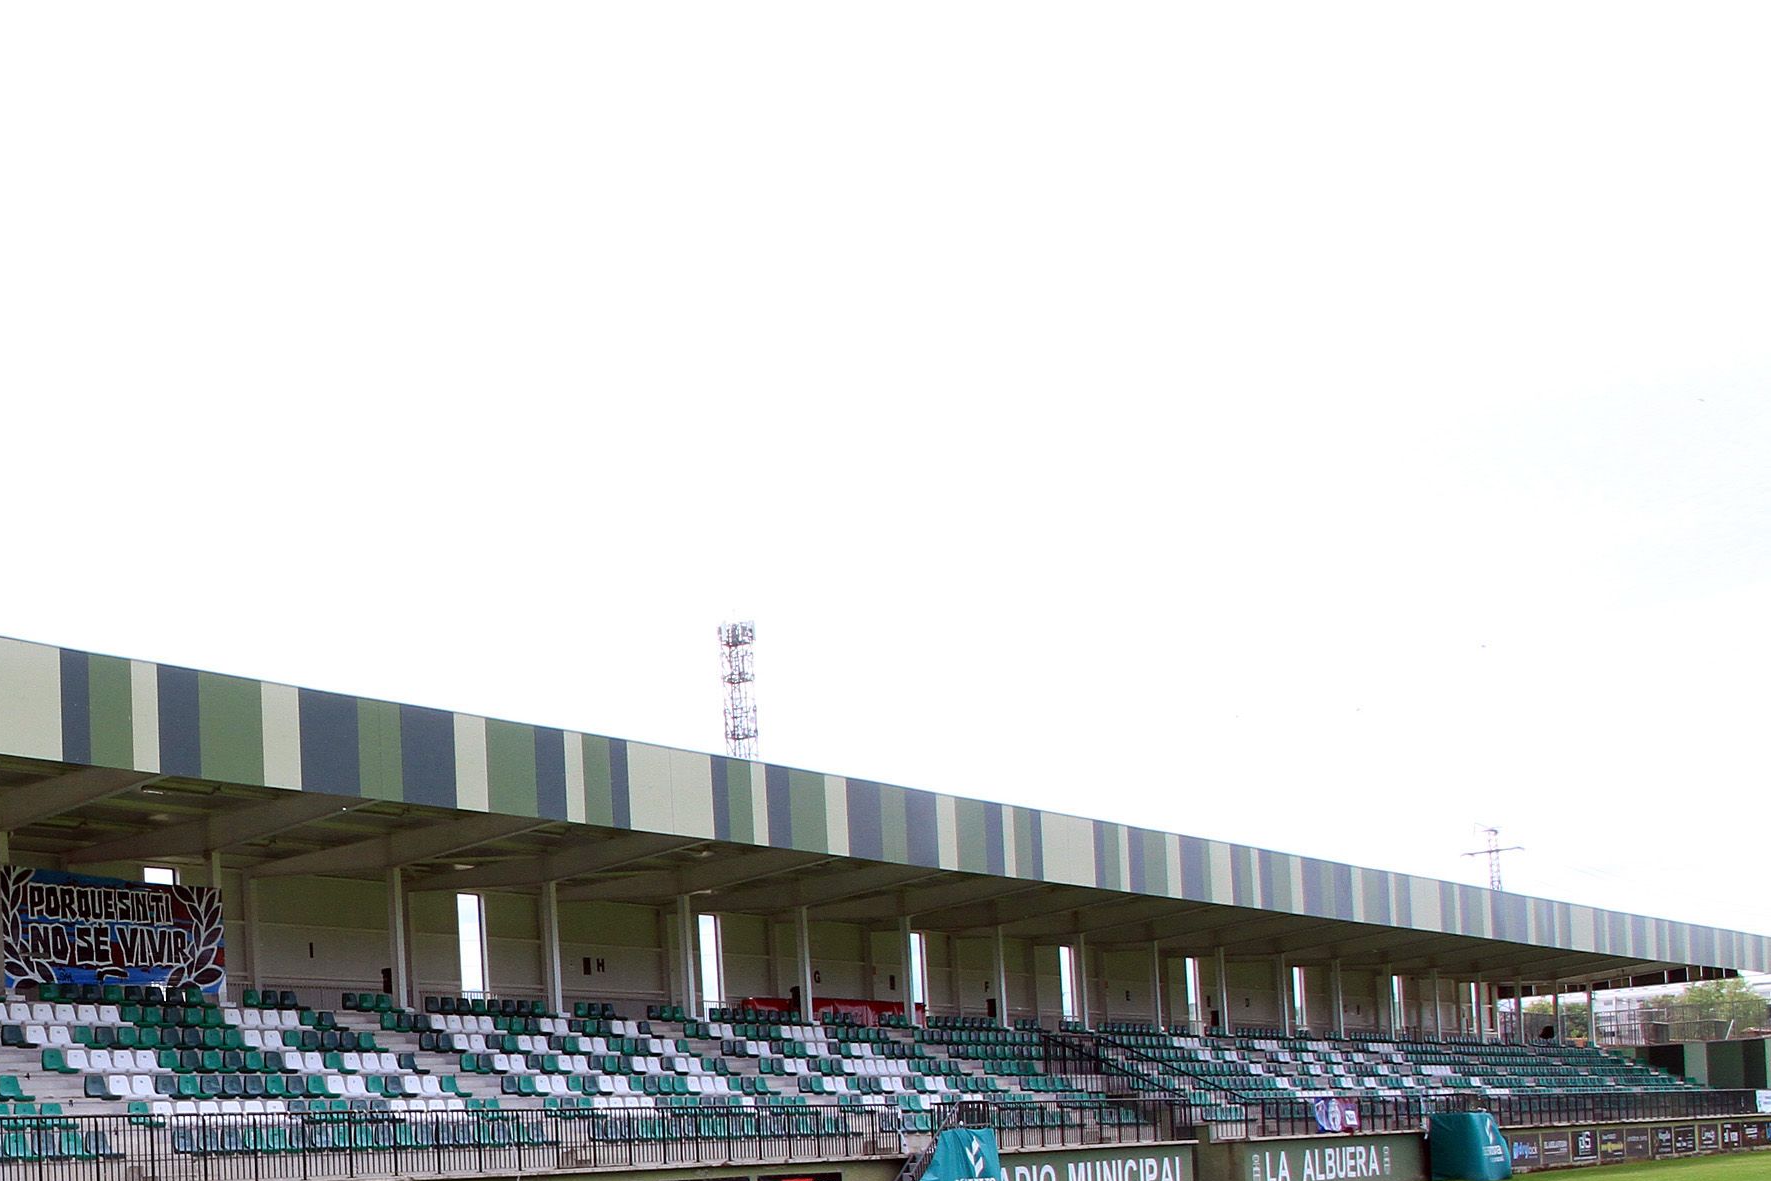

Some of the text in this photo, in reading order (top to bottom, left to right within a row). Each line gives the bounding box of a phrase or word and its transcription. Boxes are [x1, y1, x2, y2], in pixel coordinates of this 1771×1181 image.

[28, 883, 174, 926] PORQUE SIN TI
[28, 923, 70, 965] NO
[115, 925, 194, 967] VIVIR
[596, 958, 605, 973] H
